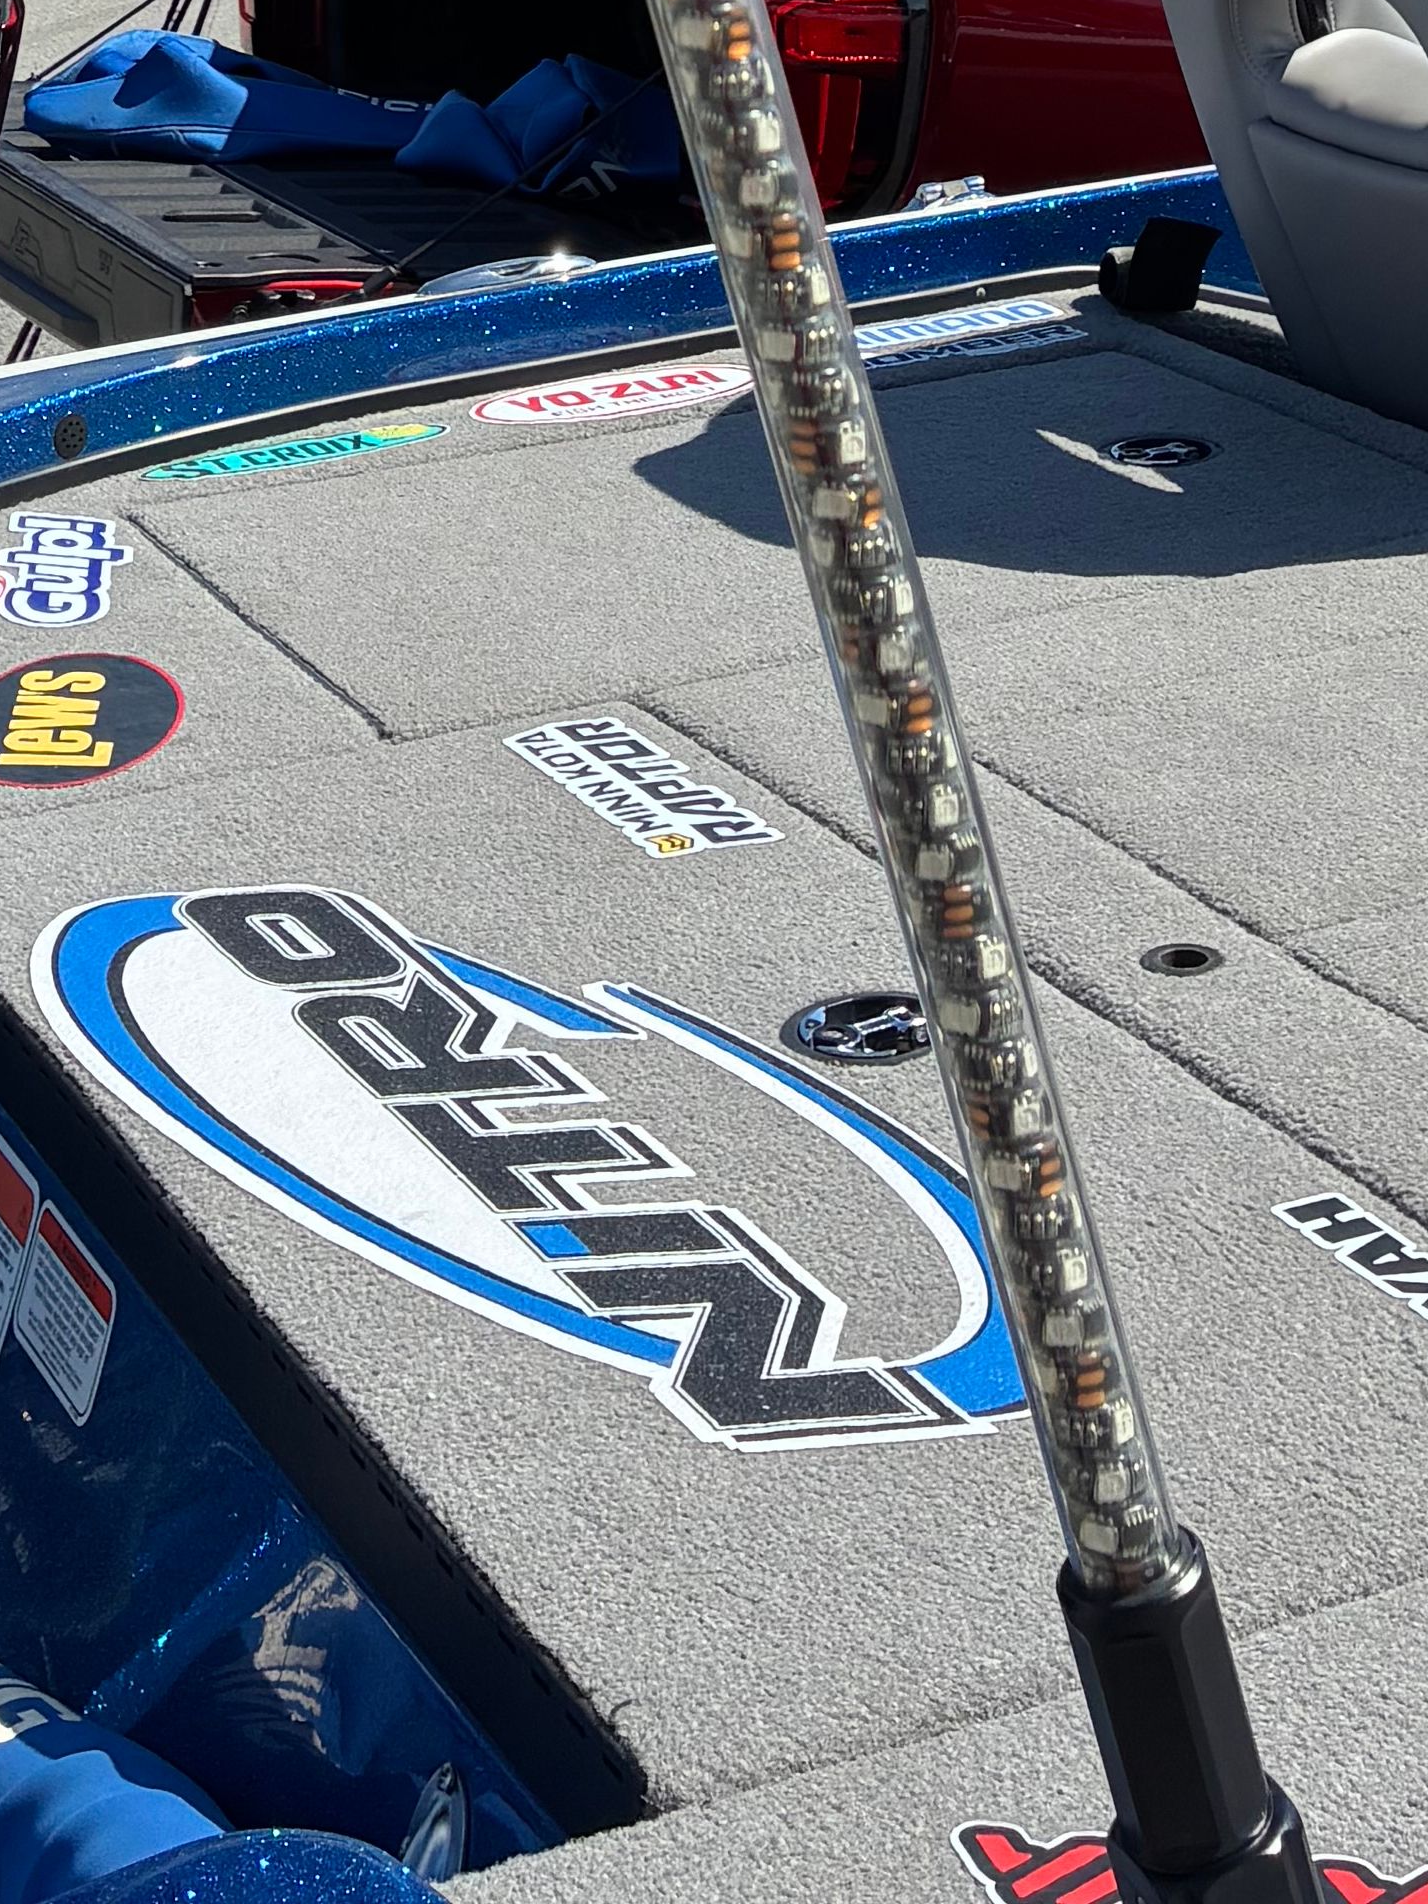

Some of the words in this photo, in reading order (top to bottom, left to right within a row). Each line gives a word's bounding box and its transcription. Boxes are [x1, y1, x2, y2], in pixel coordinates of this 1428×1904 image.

[857, 303, 1054, 345] IMANO
[864, 324, 1078, 368] OMBER
[504, 370, 727, 413] YO-ZURI
[4, 515, 125, 624] Gulp!
[515, 730, 603, 780] KOTA
[554, 720, 773, 844] RAPTOR
[578, 779, 675, 834] MINN
[175, 885, 989, 1450] NITRO
